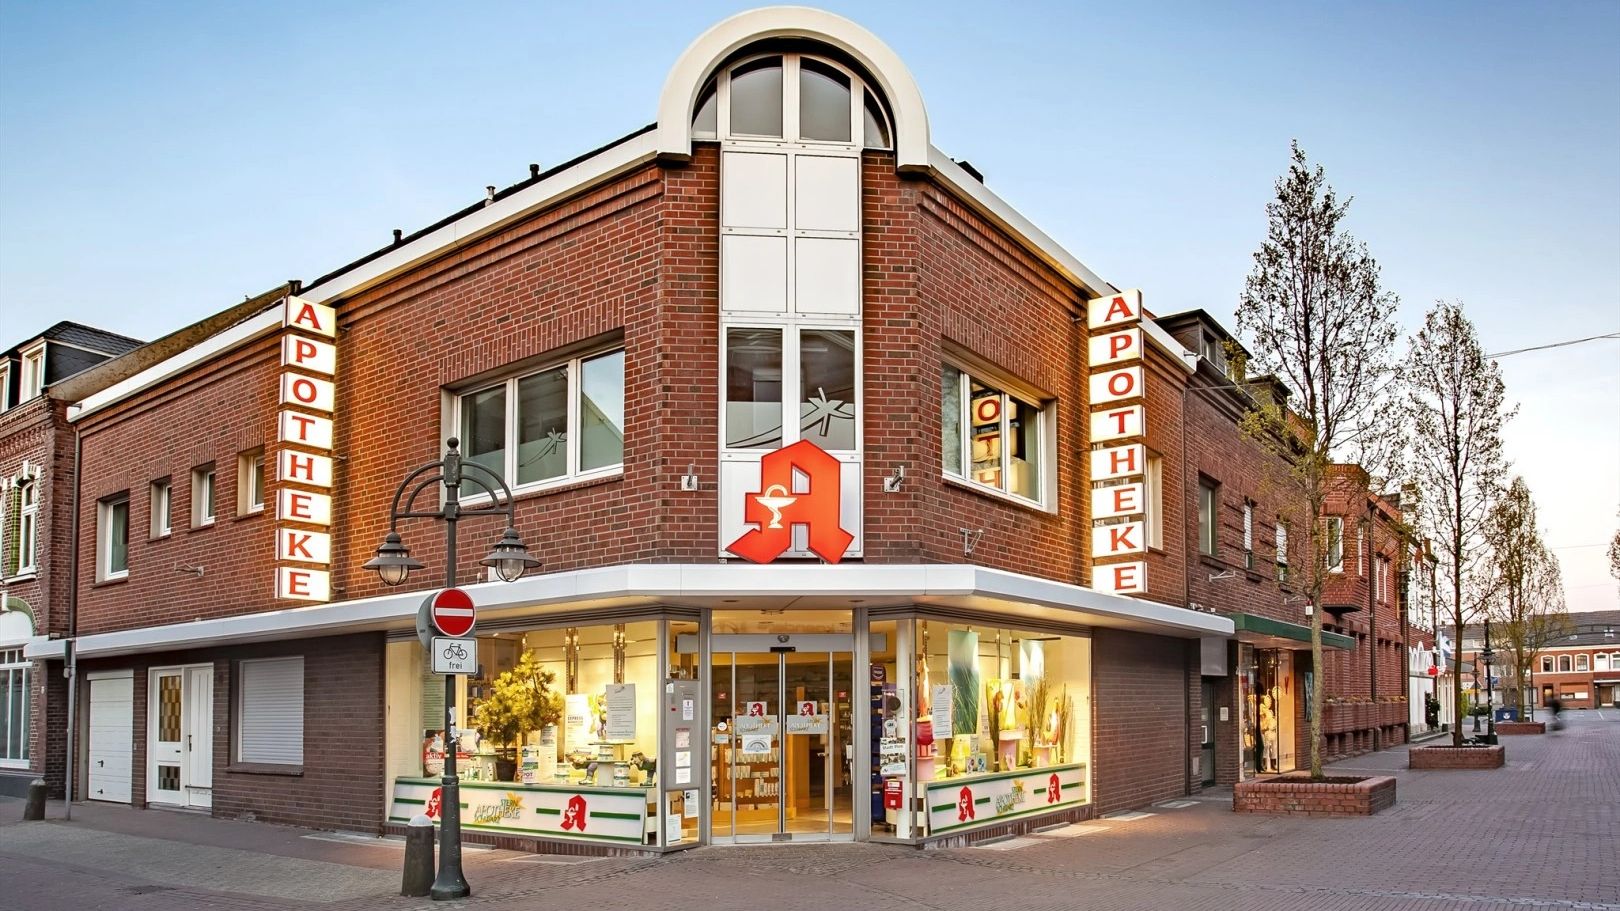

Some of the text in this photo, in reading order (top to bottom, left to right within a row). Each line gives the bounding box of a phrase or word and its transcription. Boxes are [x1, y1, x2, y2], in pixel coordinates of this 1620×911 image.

[288, 303, 322, 597] APOTHEKE
[725, 439, 855, 564] A
[1103, 296, 1137, 591] APOTHEKE
[449, 661, 463, 670] frei
[474, 804, 521, 820] APOTHEKE
